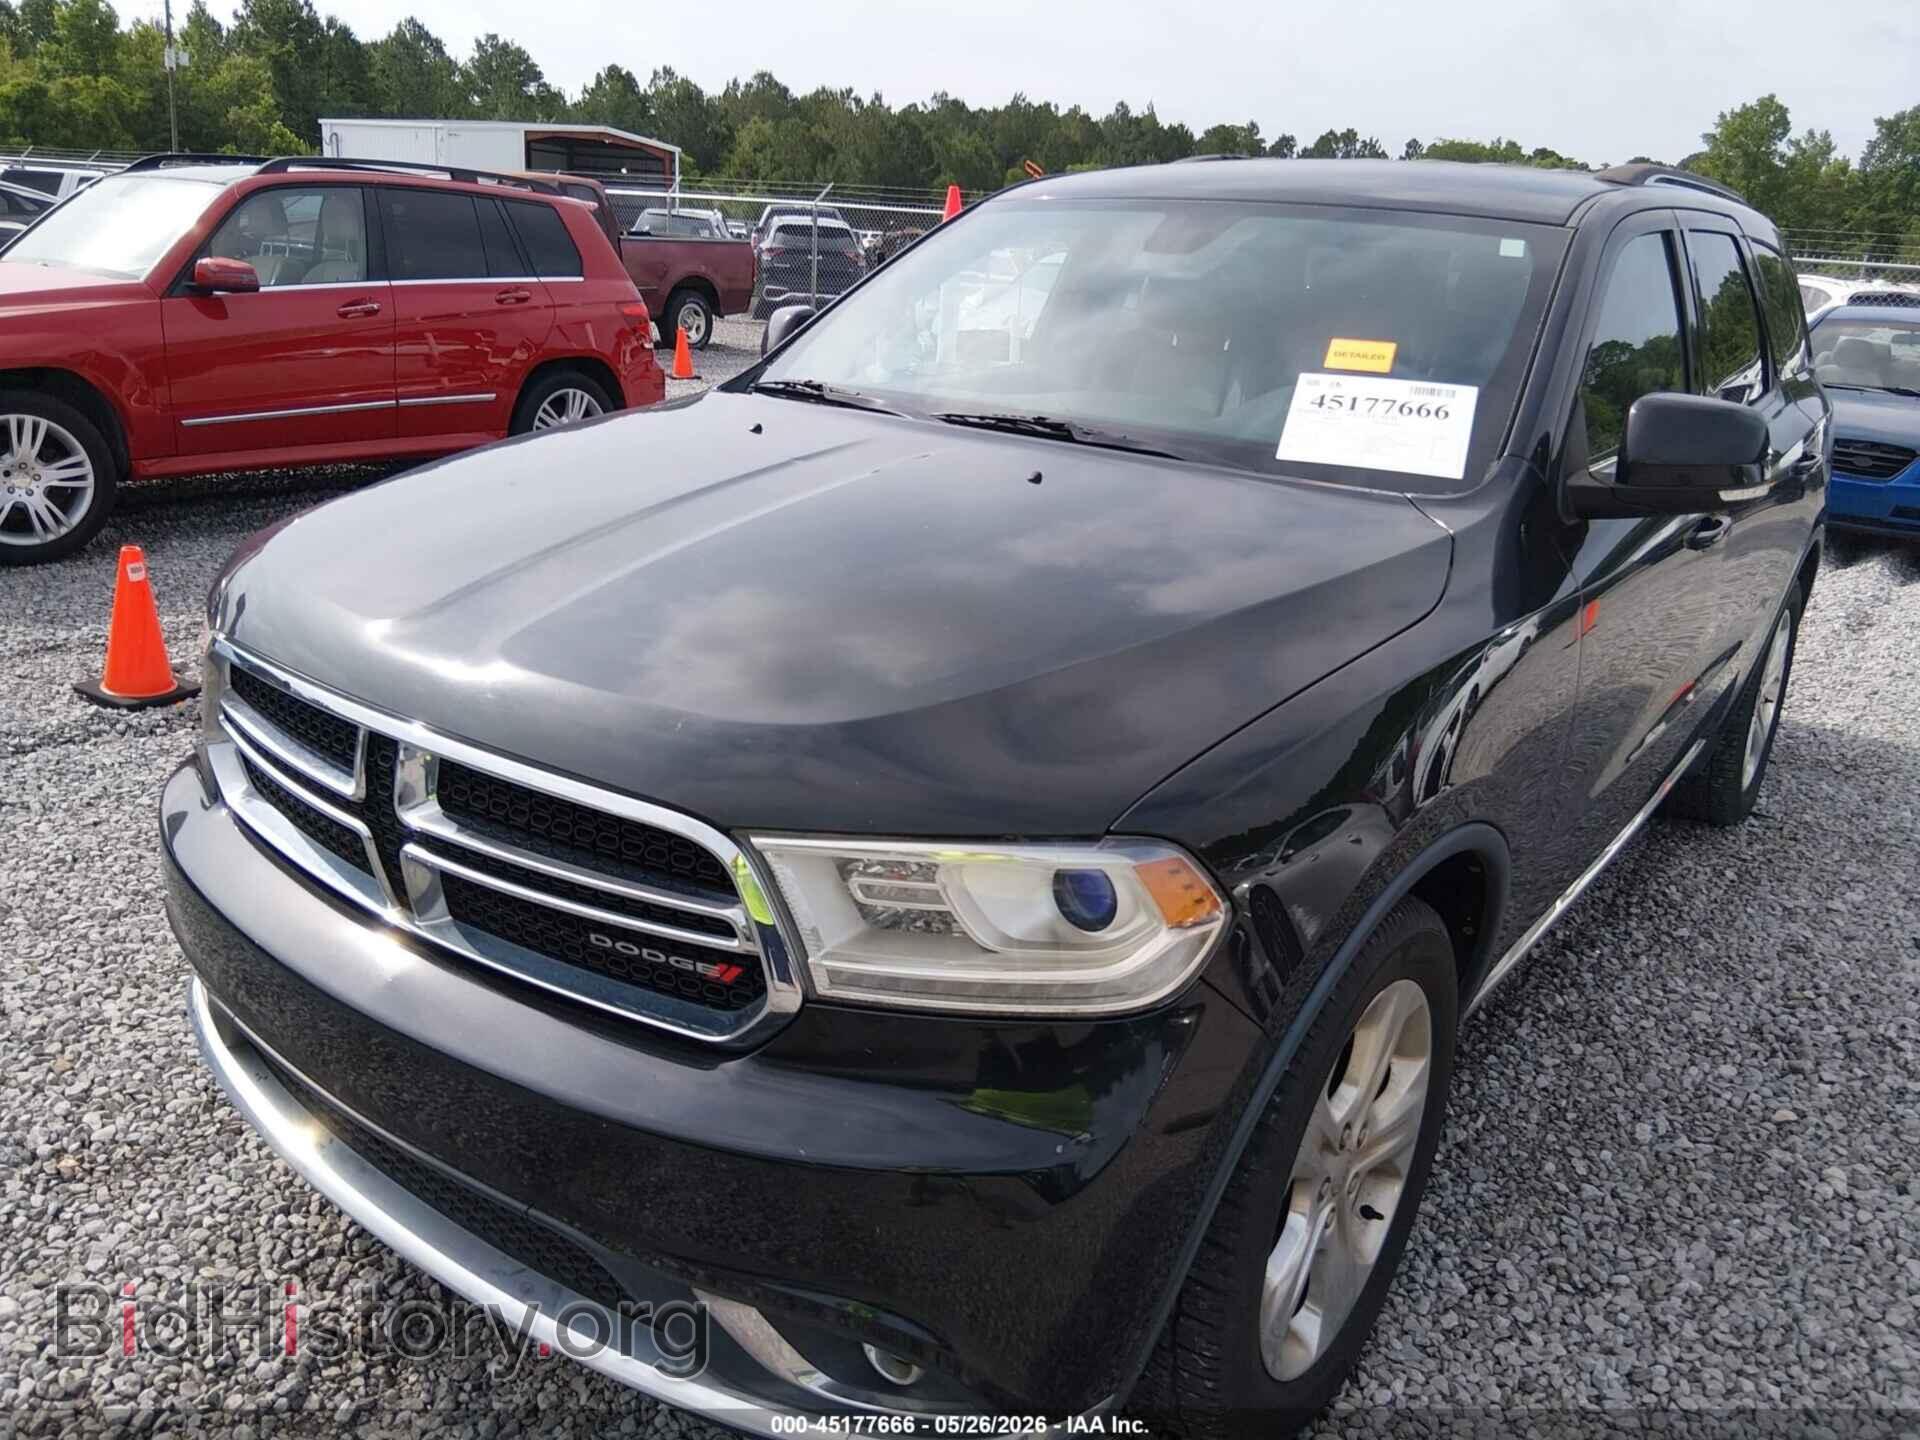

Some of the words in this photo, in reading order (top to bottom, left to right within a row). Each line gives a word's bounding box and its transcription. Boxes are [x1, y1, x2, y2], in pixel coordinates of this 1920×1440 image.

[1333, 350, 1386, 361] DETAILED
[1309, 393, 1450, 421] 45177666
[589, 933, 721, 977] DODGE
